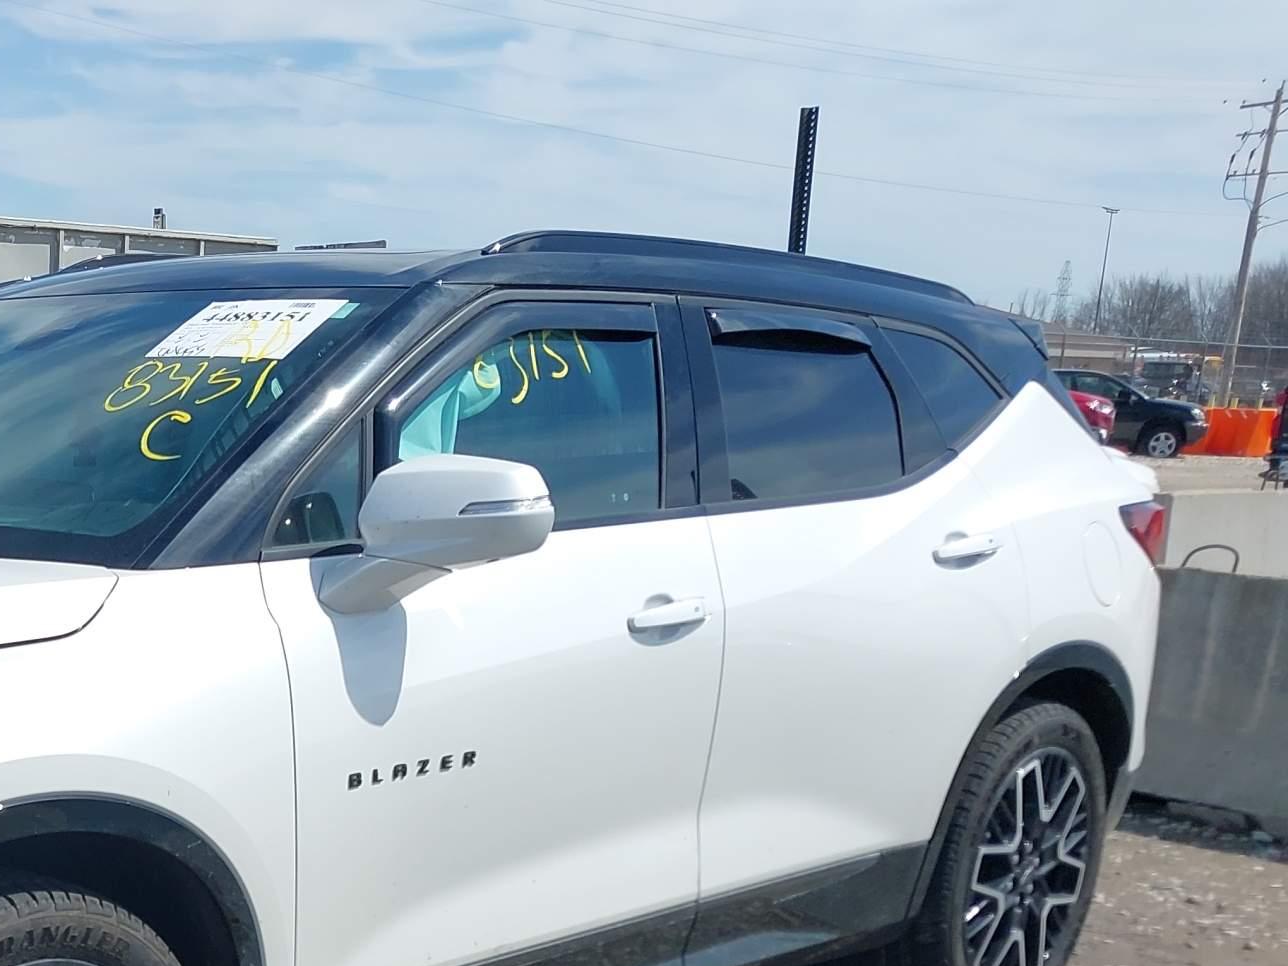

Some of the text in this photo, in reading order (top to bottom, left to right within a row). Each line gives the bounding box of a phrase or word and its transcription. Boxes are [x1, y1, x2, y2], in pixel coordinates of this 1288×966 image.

[202, 311, 312, 322] 44883151
[104, 359, 279, 412] 83151
[140, 409, 192, 461] C
[347, 750, 477, 791] BLAZER
